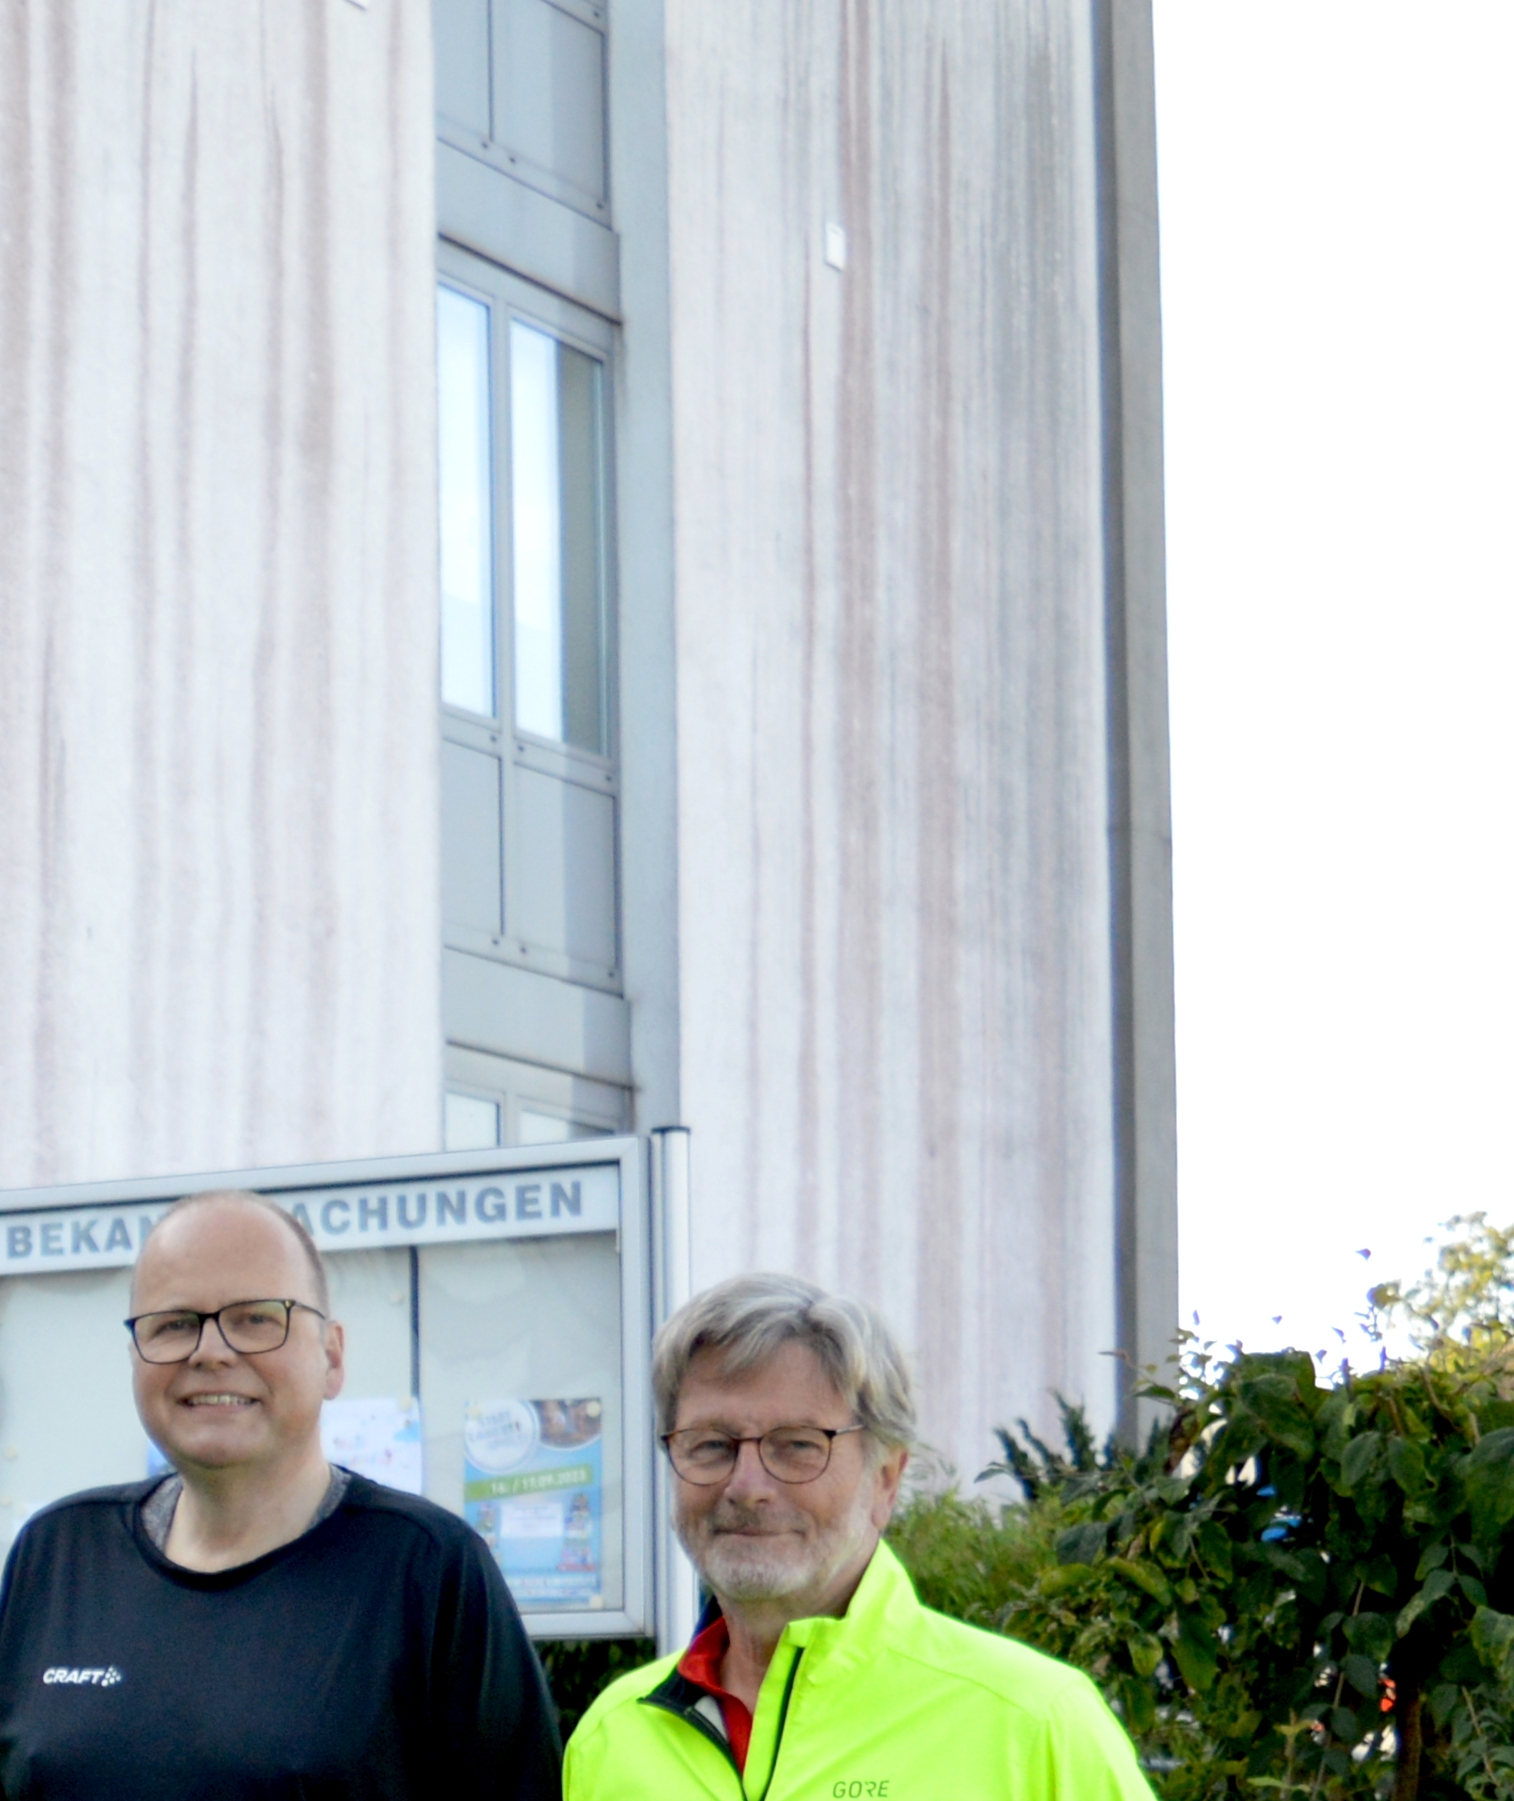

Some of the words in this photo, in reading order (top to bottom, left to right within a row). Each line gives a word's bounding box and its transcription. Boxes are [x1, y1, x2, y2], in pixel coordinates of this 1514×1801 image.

[5, 1180, 584, 1260] BEKANACHUNGEN
[43, 1667, 105, 1685] CRAFT
[832, 1780, 890, 1799] GORE
